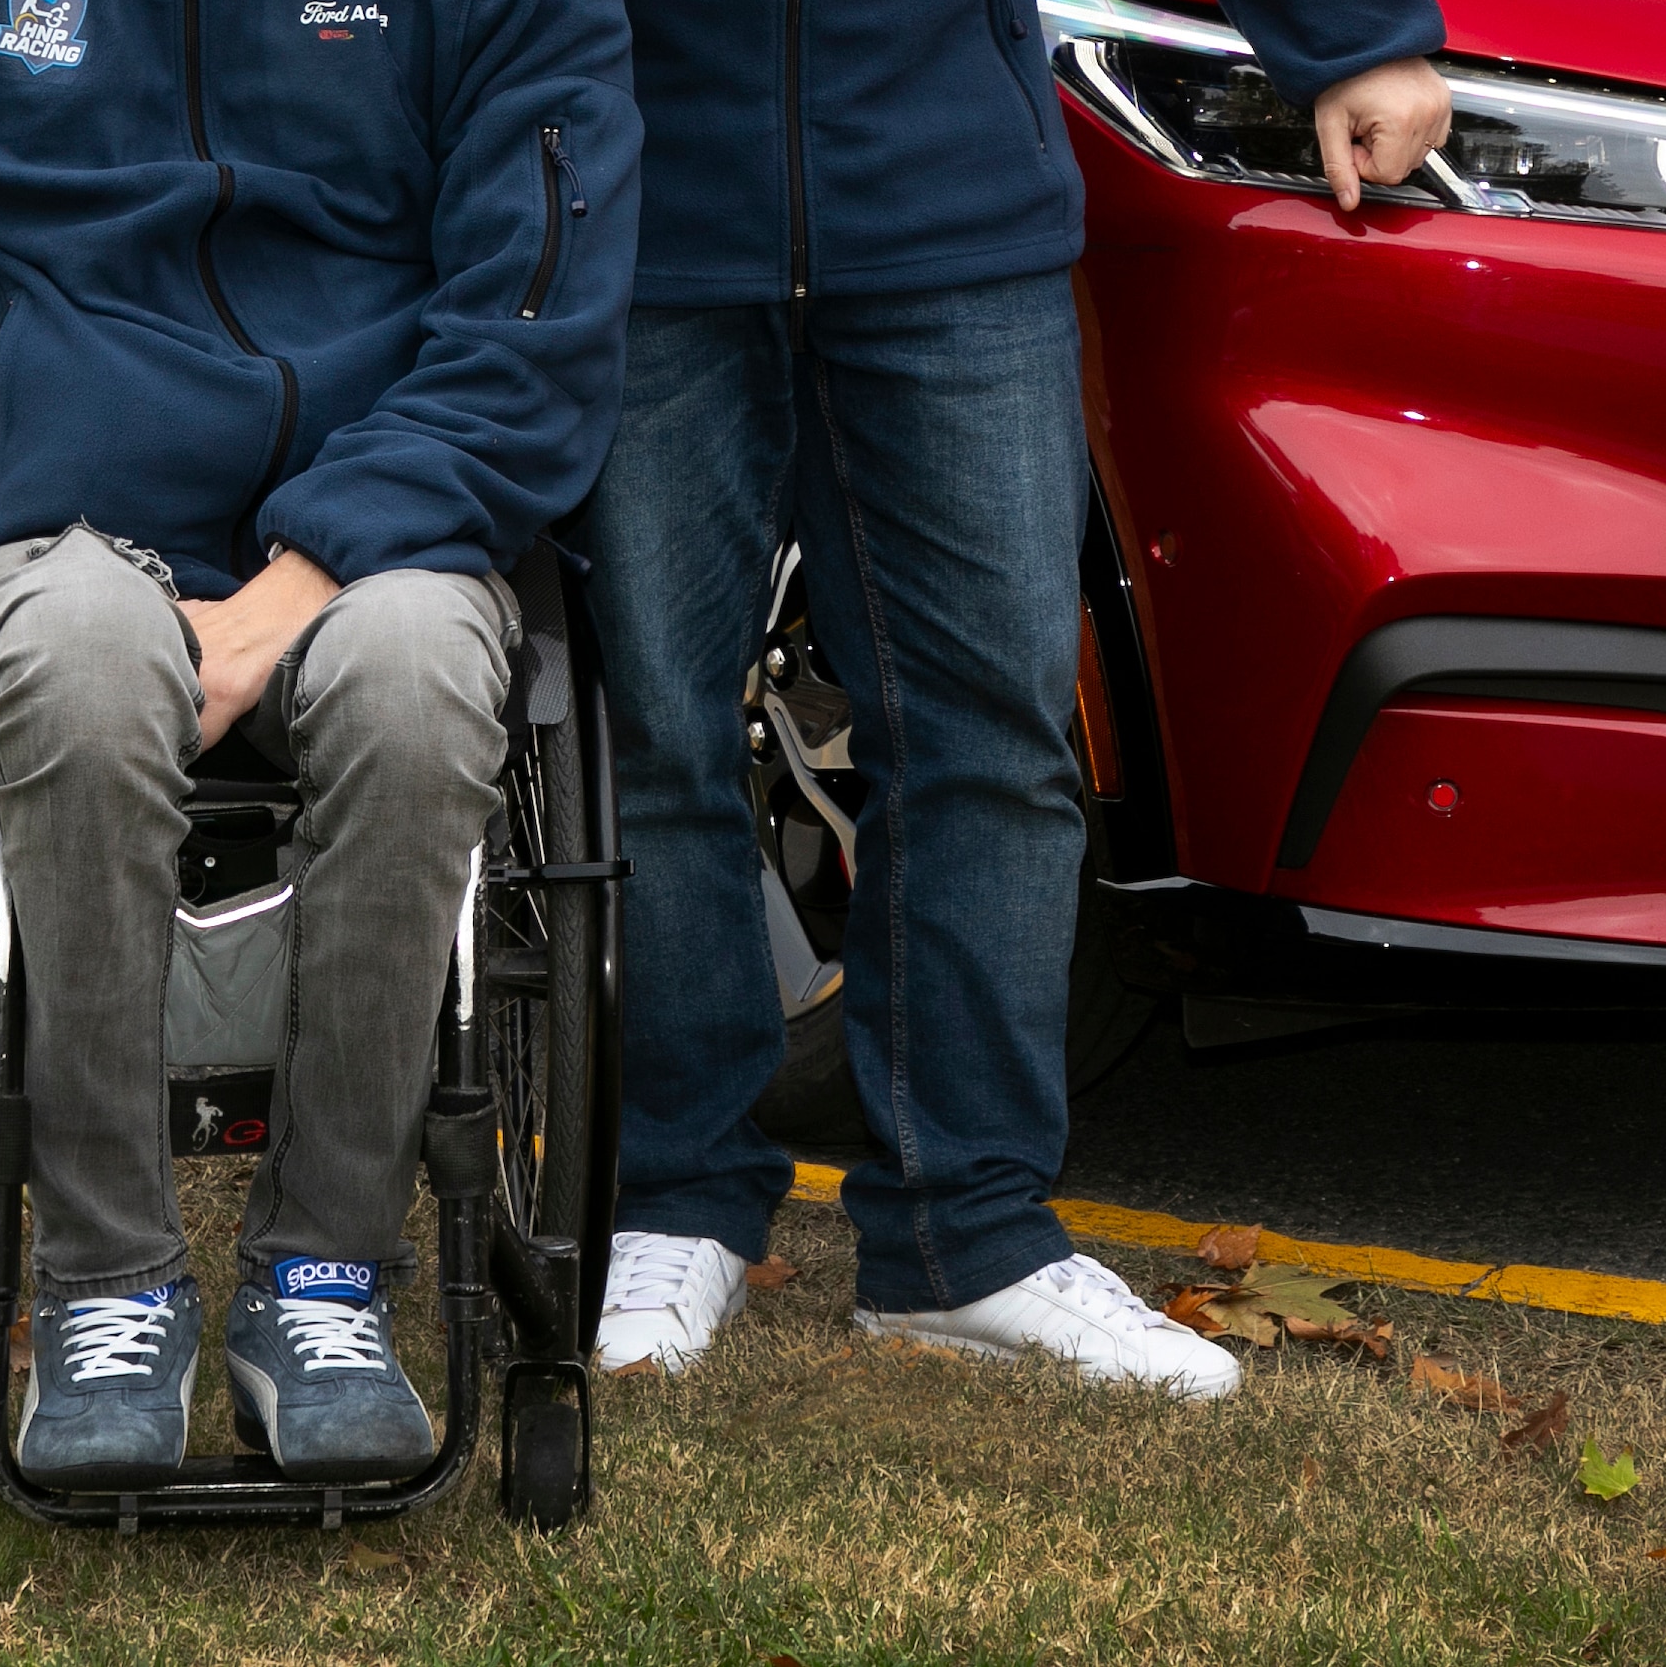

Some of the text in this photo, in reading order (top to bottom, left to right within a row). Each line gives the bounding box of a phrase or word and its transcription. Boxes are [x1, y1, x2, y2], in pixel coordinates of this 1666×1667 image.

[299, 0, 350, 25] Ford
[19, 20, 69, 45] HNP
[286, 1260, 371, 1291] sparco
